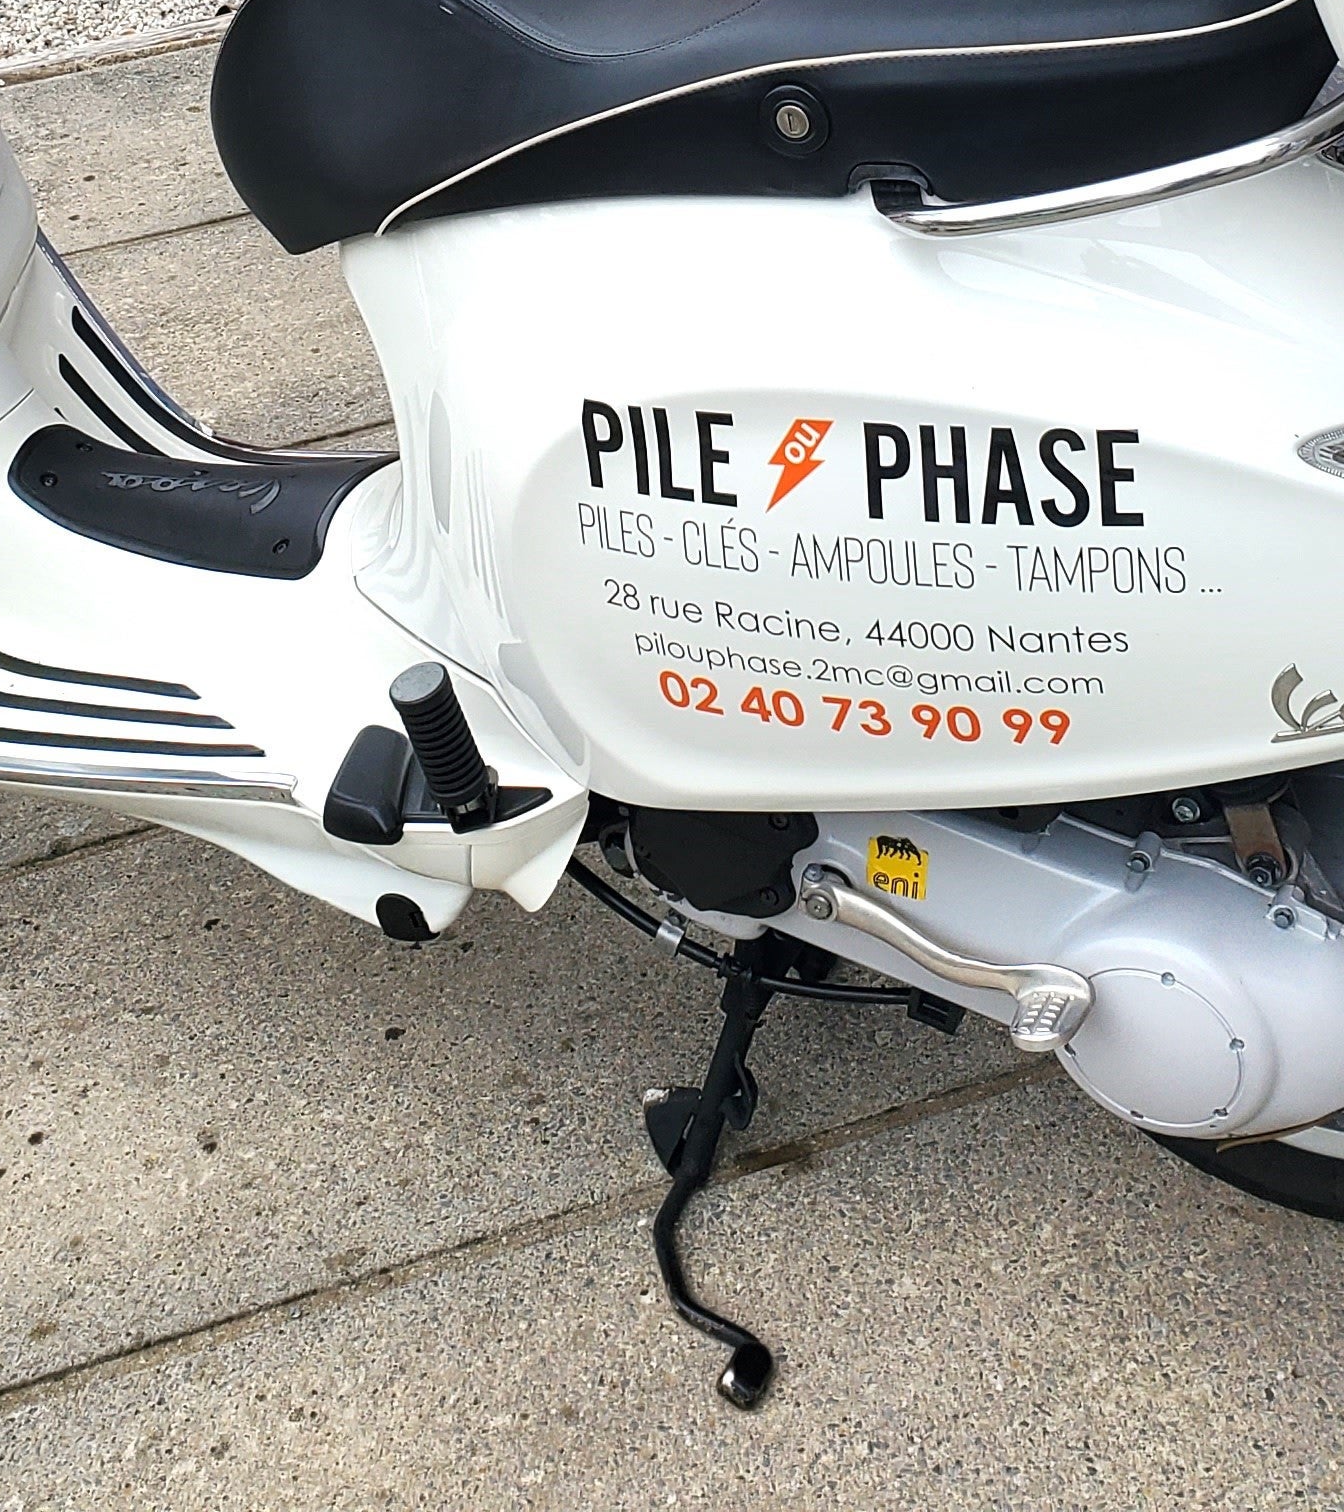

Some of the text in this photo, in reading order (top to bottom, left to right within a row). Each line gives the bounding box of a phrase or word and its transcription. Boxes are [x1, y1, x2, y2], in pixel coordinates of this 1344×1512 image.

[581, 398, 1145, 527] PILE ou PHASE
[578, 502, 657, 558] PILES
[681, 518, 760, 574] CLÉS
[790, 532, 975, 589] AMPOULES
[1007, 544, 1187, 594] TAMPONS
[603, 578, 1130, 655] 28 rue Racine, 44000 Nantes
[634, 632, 1106, 697] pilouphase.2mc@gmail.com
[659, 670, 1071, 746] 02 40 73 90 99
[873, 872, 919, 900] eni
